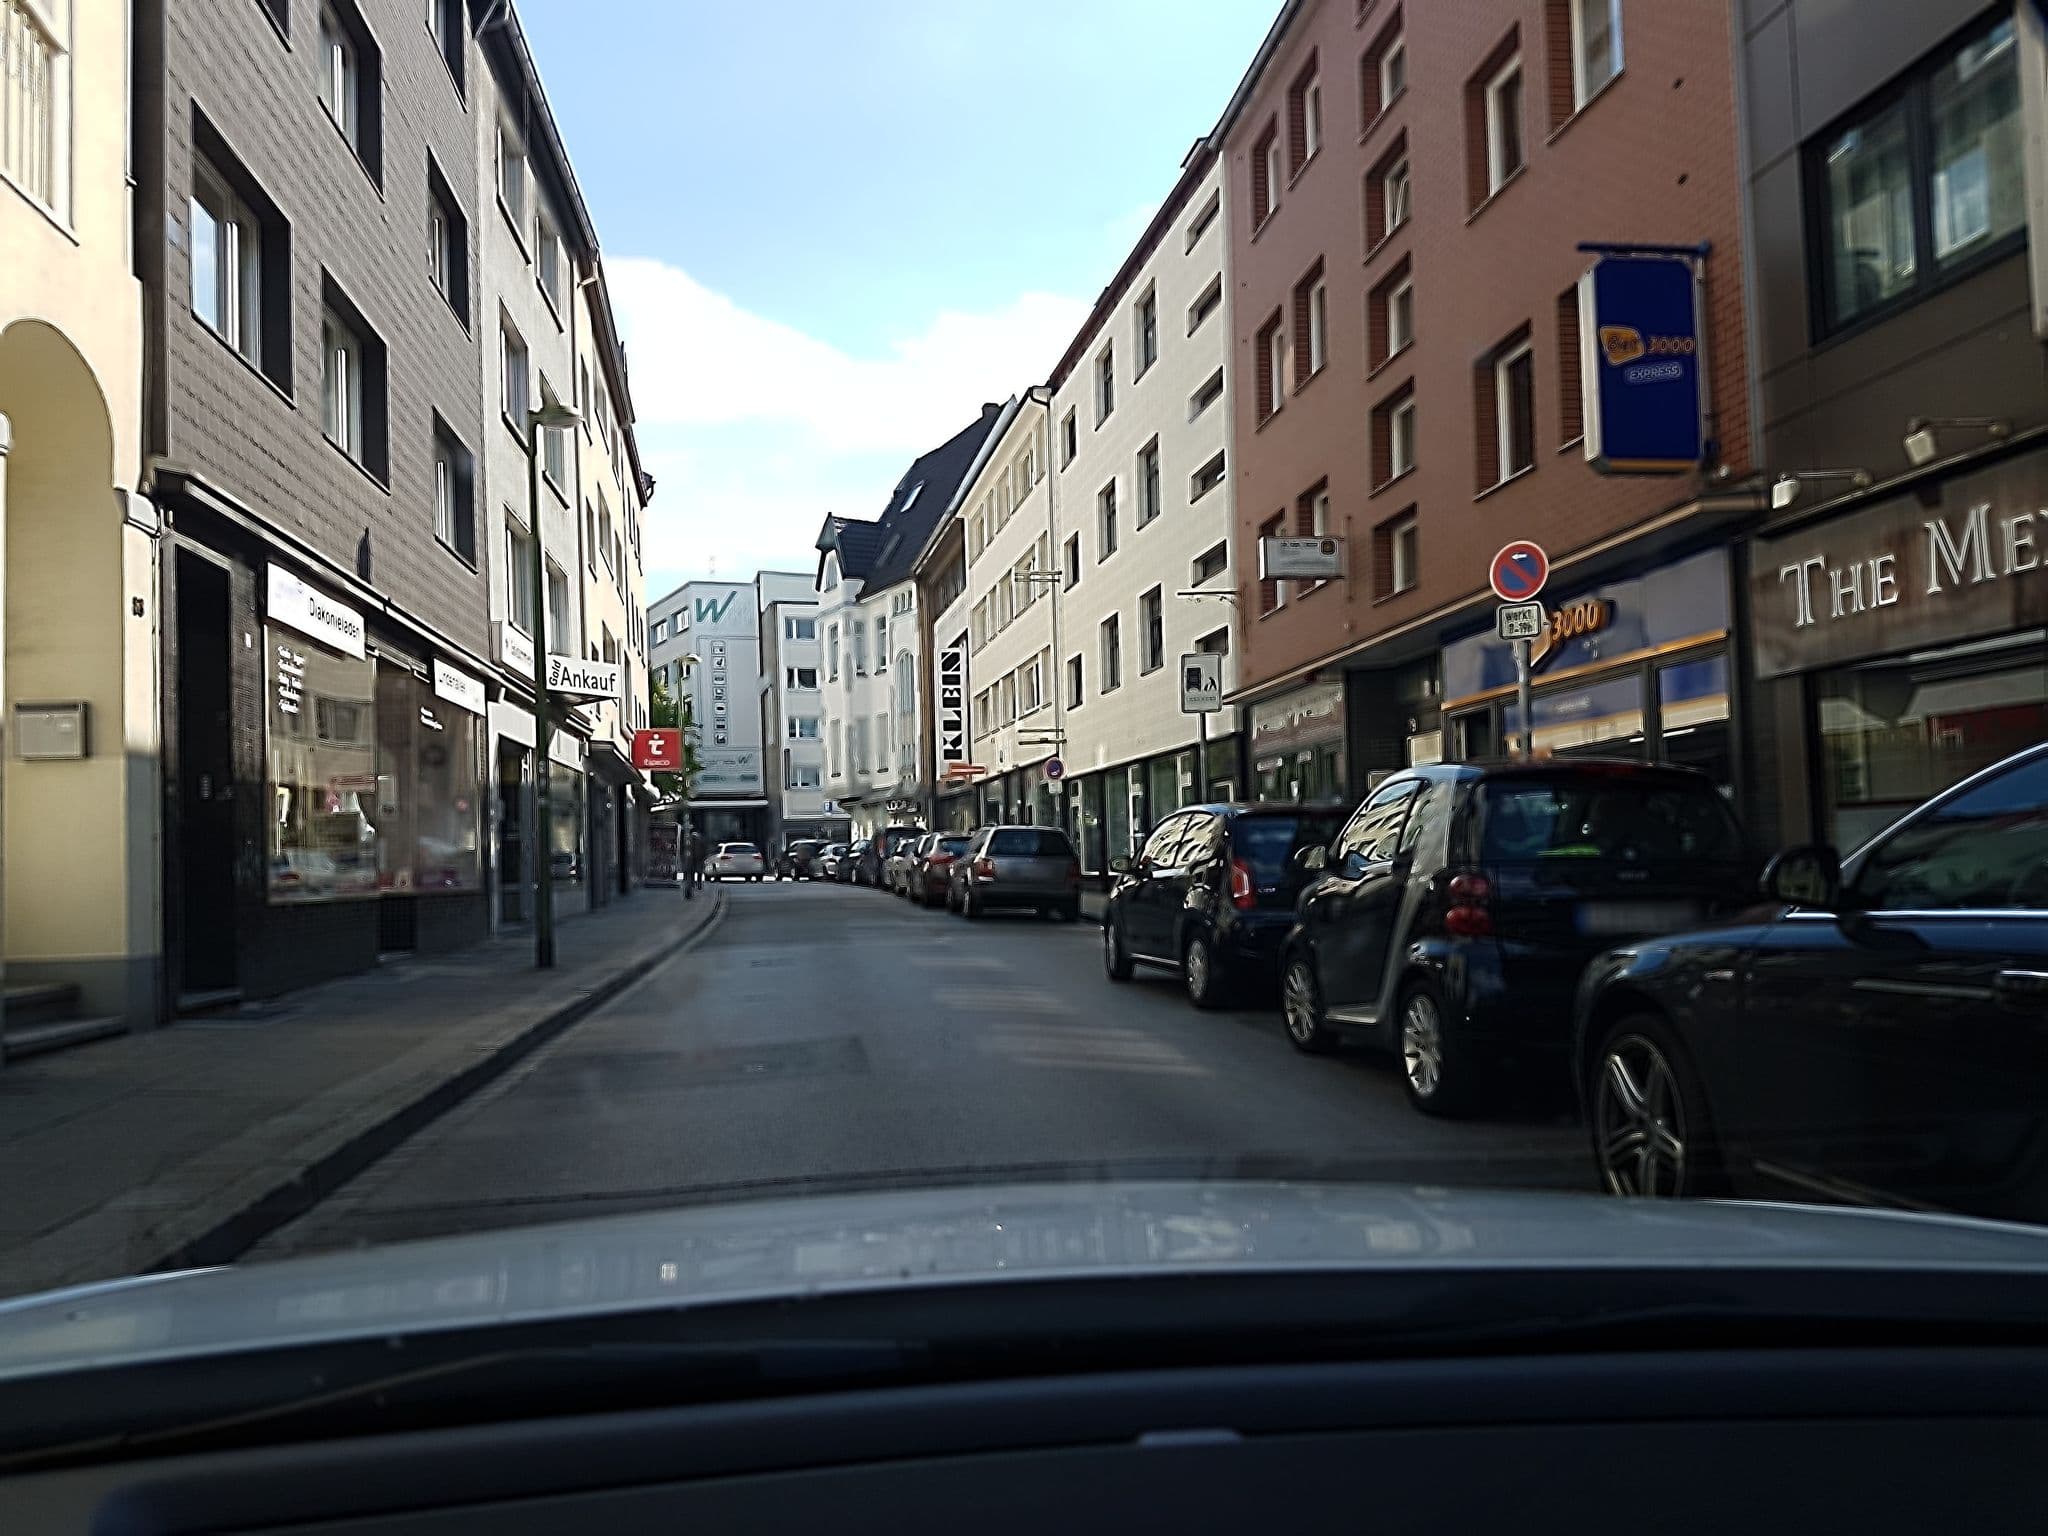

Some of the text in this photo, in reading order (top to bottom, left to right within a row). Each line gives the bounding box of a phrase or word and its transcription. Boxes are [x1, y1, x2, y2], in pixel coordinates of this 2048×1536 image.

[1647, 336, 1695, 353] 3000
[1924, 503, 2048, 595] ME
[1551, 602, 1599, 641] 3000
[549, 659, 616, 692] Gold Ankauf
[941, 652, 963, 760] KLEIN
